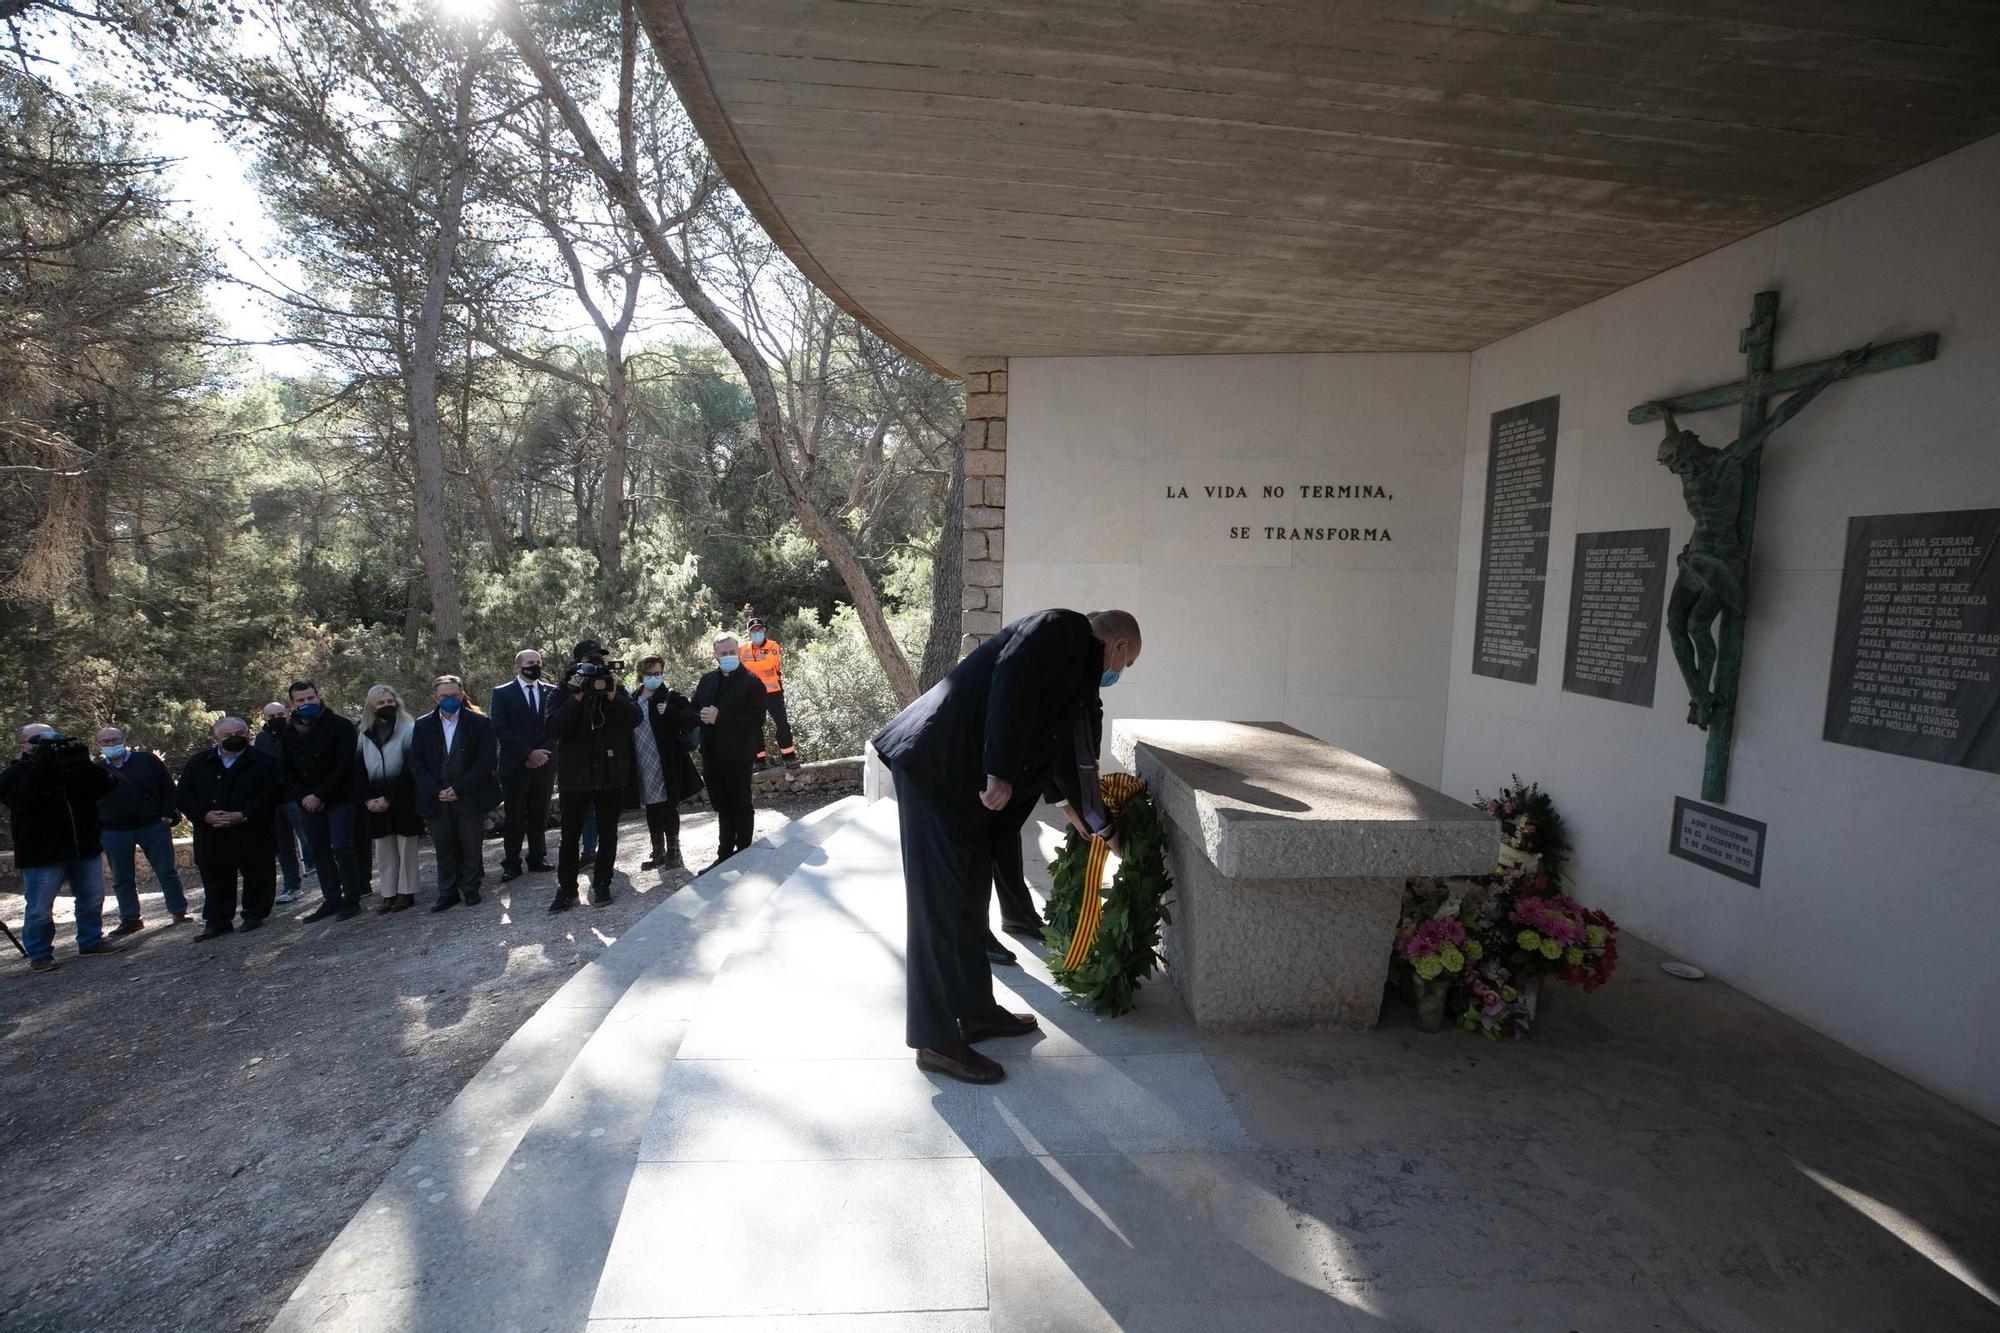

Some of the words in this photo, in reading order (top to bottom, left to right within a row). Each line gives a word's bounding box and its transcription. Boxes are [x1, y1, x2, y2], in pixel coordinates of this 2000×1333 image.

[1166, 486, 1189, 499] LA
[1205, 486, 1248, 499] VIDA
[1262, 485, 1285, 499] NO
[1300, 485, 1393, 501] TERMINA,
[1230, 527, 1250, 539] SE
[1264, 527, 1392, 541] TRANSFORMA
[1903, 538, 1926, 548] LUNA
[1930, 536, 1974, 547] SERRANO
[1869, 549, 1888, 558] ANA
[1905, 548, 1930, 558] JUAN
[1933, 546, 1981, 557] PLANELLS
[1916, 558, 1940, 568] LUNA
[1944, 558, 1971, 567] JUAN
[1901, 568, 1924, 577] LUNA
[1928, 568, 1955, 577] JUAN
[1865, 582, 1898, 592] MANUEL
[1902, 583, 1936, 592] MADRID
[1940, 584, 1970, 593] PEREZ
[1863, 594, 1890, 603] PEDRO
[1893, 594, 1938, 604] MARTINEZ
[1862, 605, 1885, 614] JUAN
[1888, 606, 1934, 616] MARTINEZ
[1937, 608, 1960, 617] DIAZ
[1861, 616, 1884, 625] JUAN
[1886, 617, 1932, 628] MARTINEZ
[1881, 628, 1926, 639] FRANCISCO
[1929, 631, 1975, 643] MARTINEZ
[1857, 649, 1882, 659] PILAR
[1947, 644, 1998, 657] MARTINEZ
[1856, 660, 1878, 670] JUAN
[1881, 663, 1923, 675] BAUTISTA
[1952, 669, 1990, 682] GARCIA
[1854, 672, 1876, 681] JOSE
[1909, 677, 1958, 690] TORNEROS
[1852, 682, 1878, 693] PILAR
[1851, 696, 1872, 706] JOSE
[1910, 703, 1958, 718] MARTINEZ
[1850, 705, 1877, 717] MARIA
[1880, 710, 1912, 723] GARCIA
[1916, 714, 1960, 729] NAVARRO
[1848, 714, 1870, 726] JOSE
[1922, 724, 1958, 740] GARCIA
